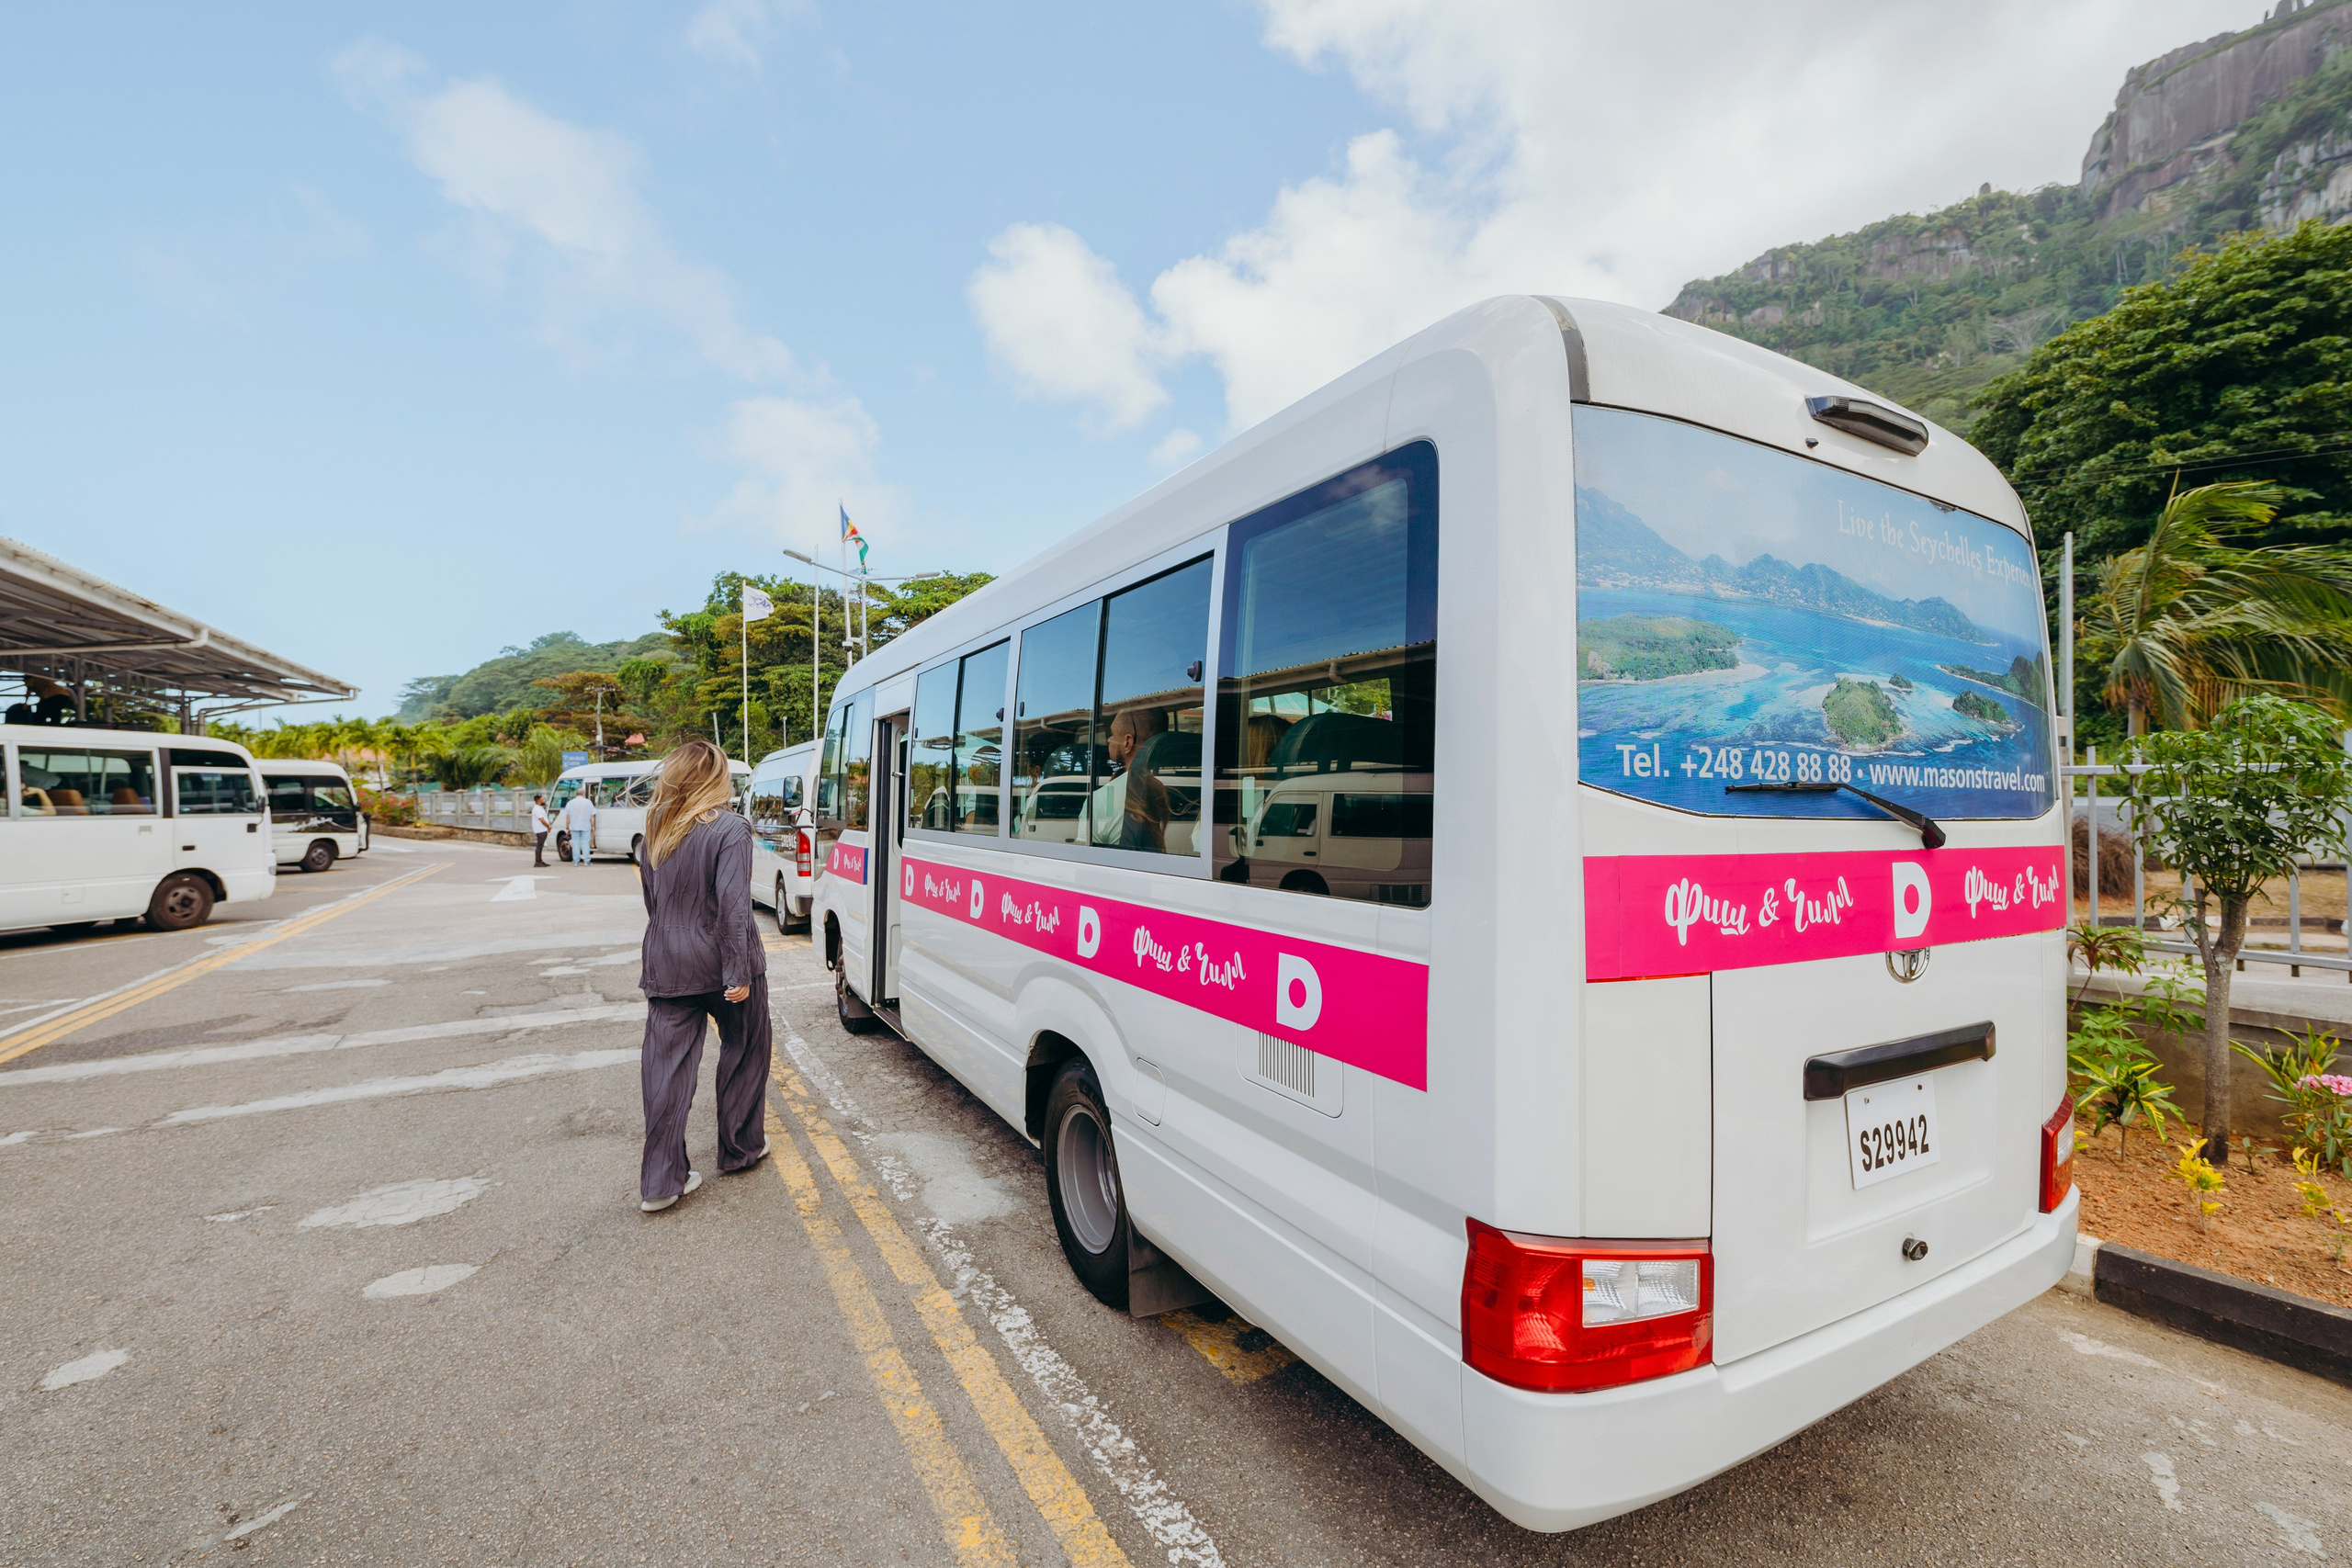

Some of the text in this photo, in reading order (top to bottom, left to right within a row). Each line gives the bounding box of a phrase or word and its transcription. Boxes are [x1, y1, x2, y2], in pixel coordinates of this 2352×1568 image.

[1837, 499, 2034, 592] Live the Seychelles Experien
[1615, 742, 1852, 784] Tel. +248 428 88 88
[1869, 762, 2045, 793] www.masonstravel.com
[1758, 887, 1780, 928] &
[1892, 861, 1932, 940] D
[2013, 873, 2025, 905] &
[905, 863, 915, 897] D
[969, 878, 985, 919] D
[1024, 904, 1033, 924] &
[1077, 905, 1102, 959] D
[1177, 944, 1192, 972] &
[1276, 952, 1323, 1032] D
[1860, 1113, 1929, 1172] S29942
